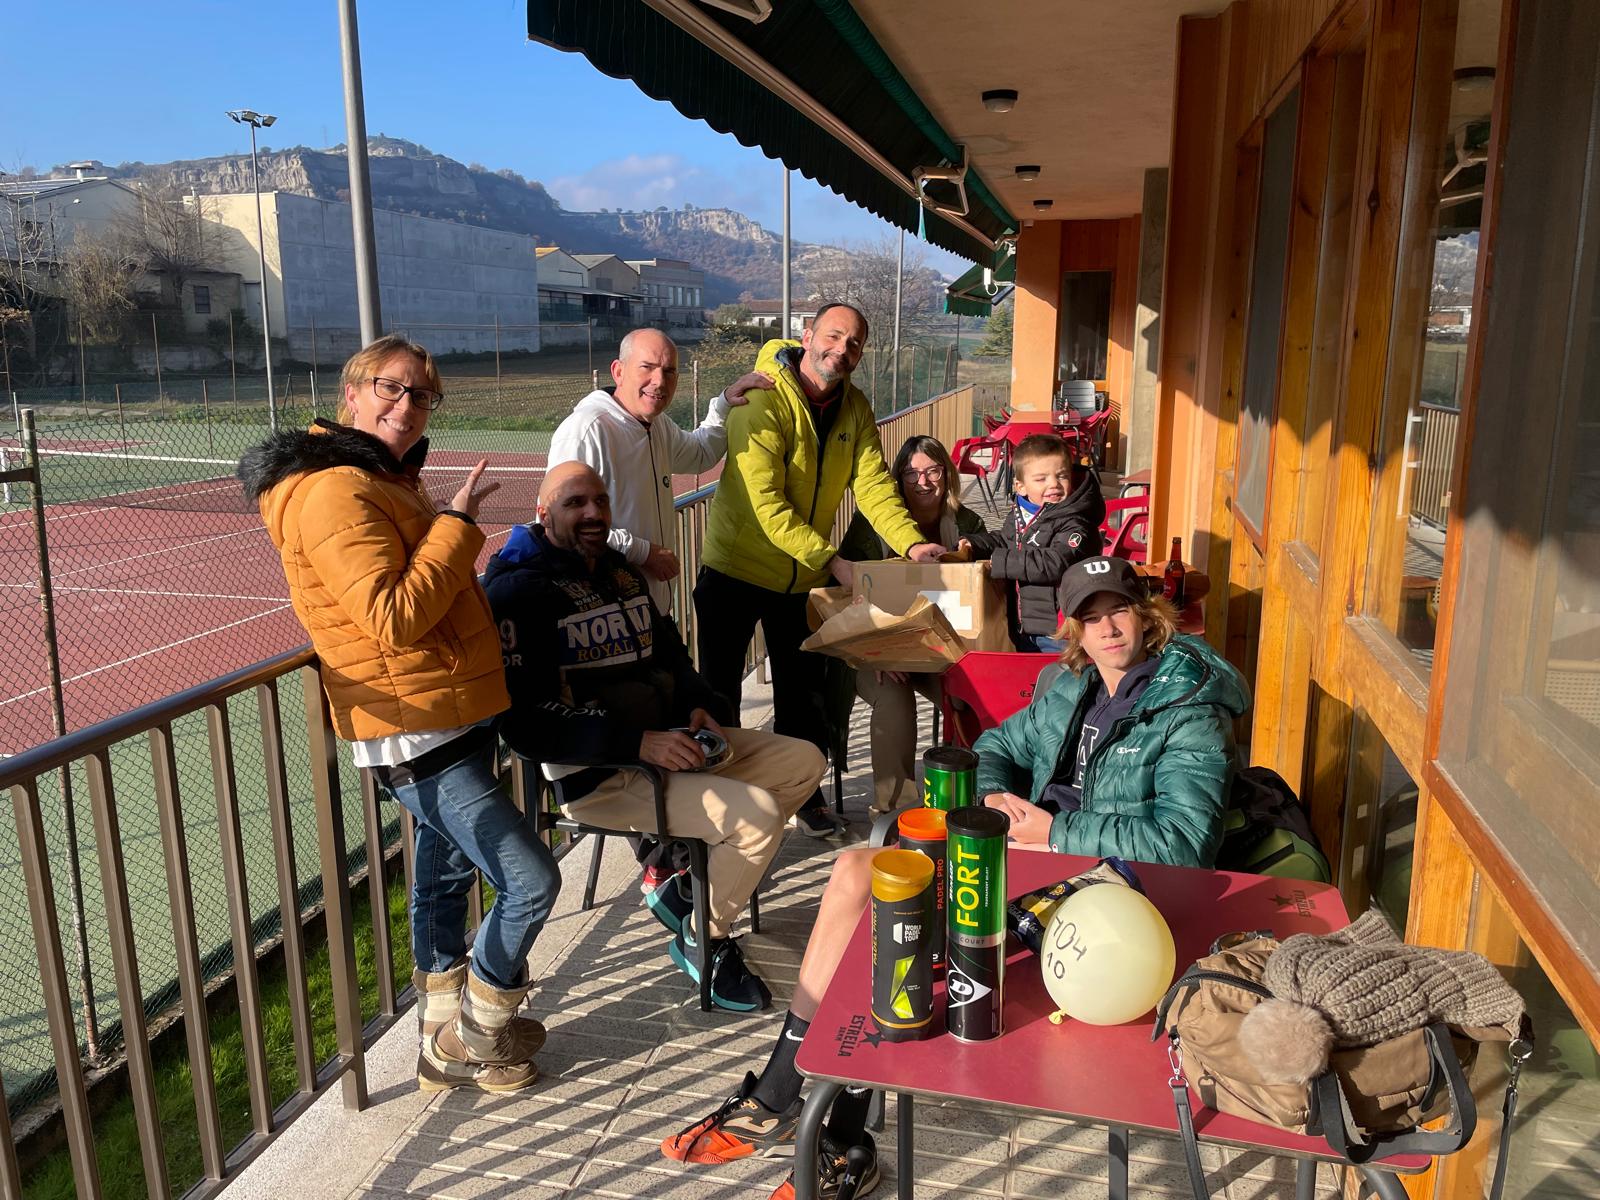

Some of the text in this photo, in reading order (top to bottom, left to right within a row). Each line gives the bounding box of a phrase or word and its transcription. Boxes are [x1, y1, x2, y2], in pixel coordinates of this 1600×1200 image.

[577, 639, 635, 662] ROYAL
[936, 858, 944, 910] PADEL PRO
[956, 844, 980, 928] FORT
[904, 935, 919, 943] TOUR
[959, 936, 985, 945] COURT
[1047, 952, 1065, 979] 10
[838, 1015, 866, 1057] ESTRELLA
